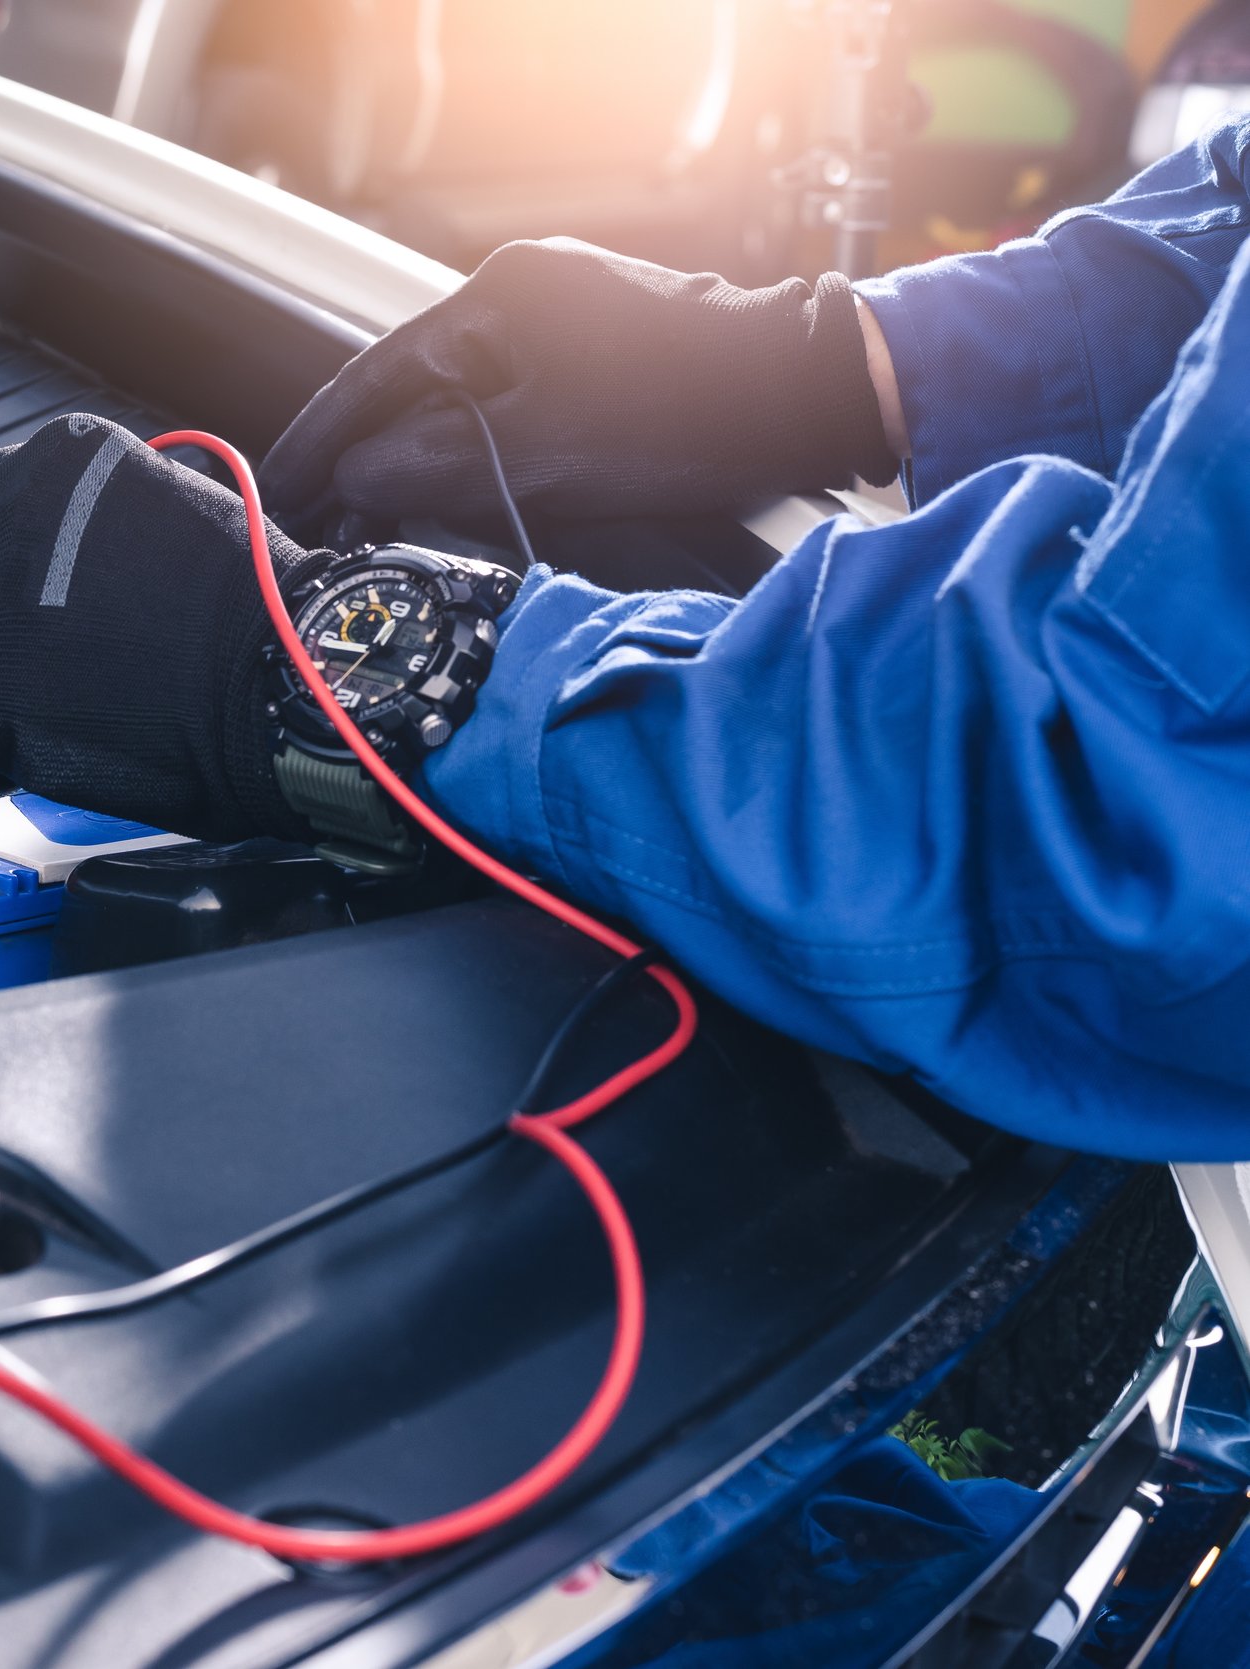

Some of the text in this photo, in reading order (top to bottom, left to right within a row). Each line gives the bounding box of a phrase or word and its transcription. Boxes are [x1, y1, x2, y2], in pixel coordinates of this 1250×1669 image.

[389, 600, 411, 618] 6
[407, 654, 428, 673] 3
[334, 688, 362, 708] 12
